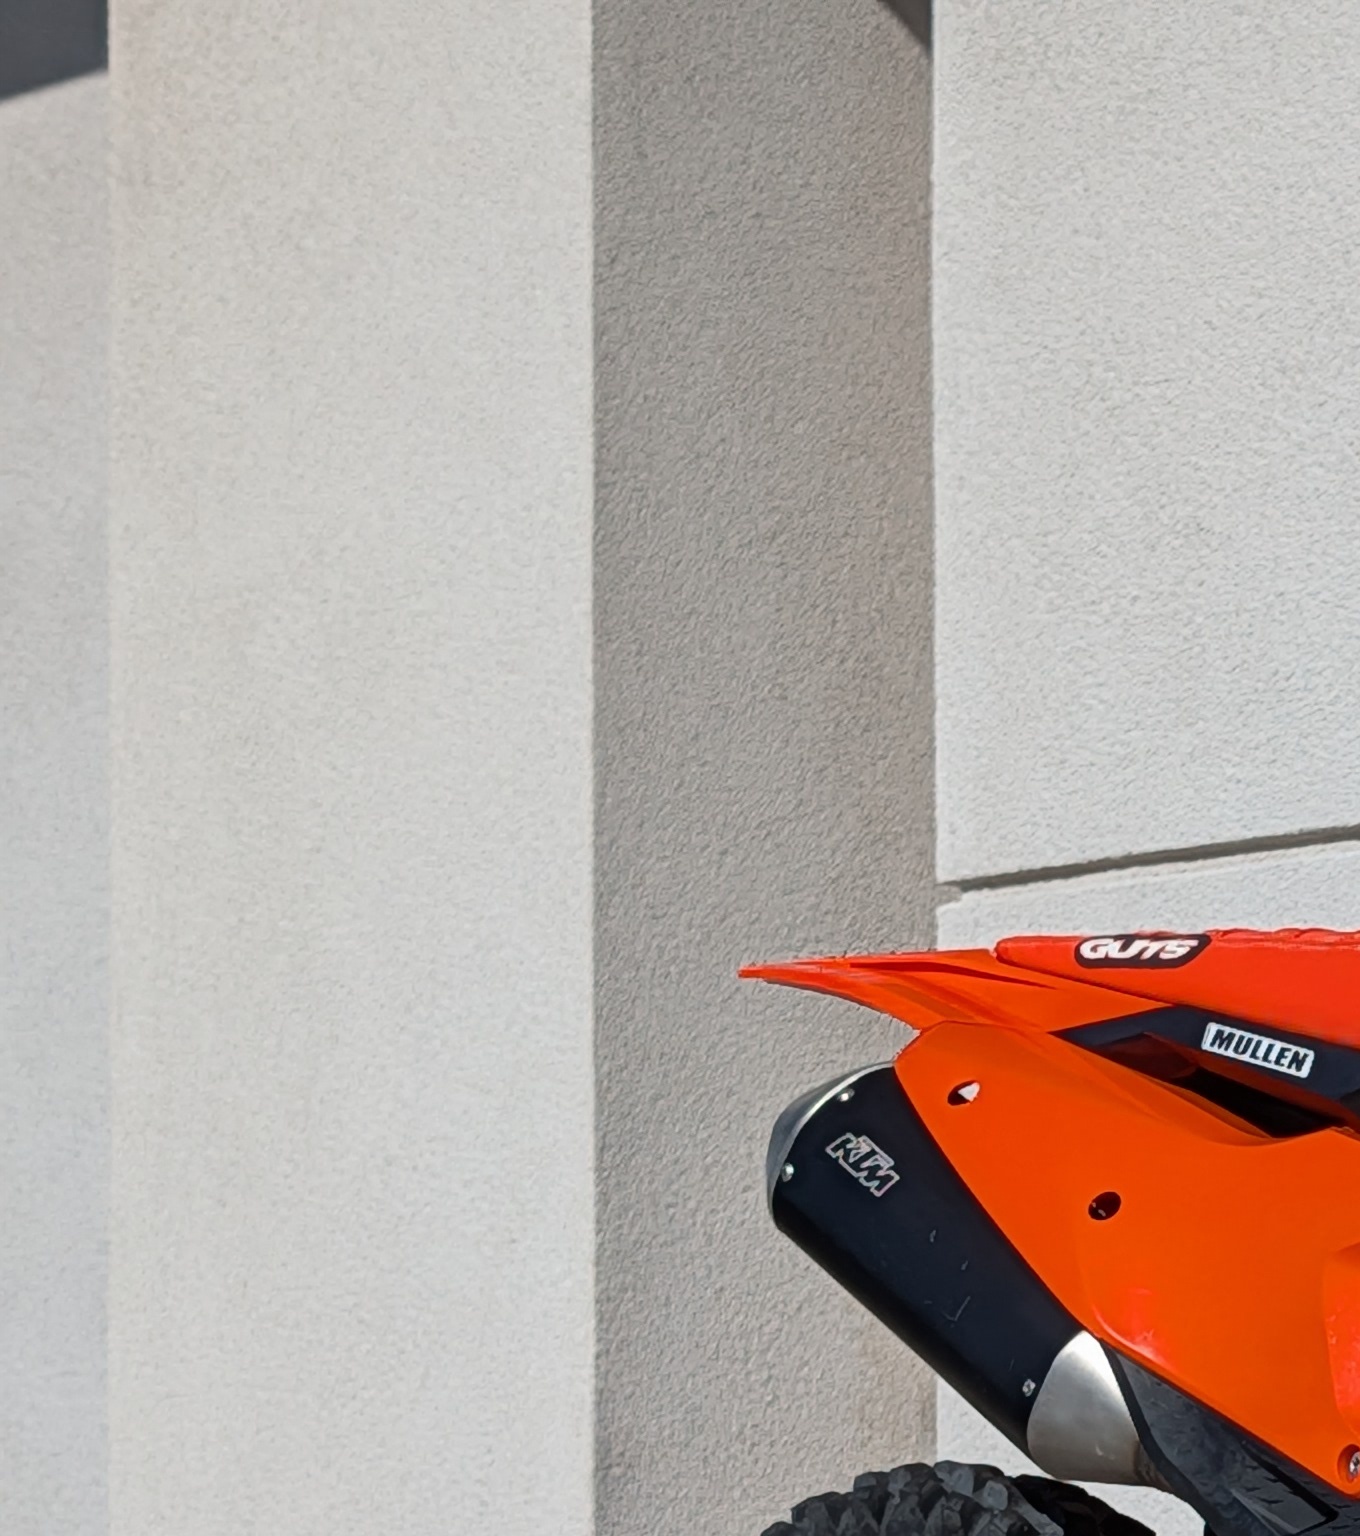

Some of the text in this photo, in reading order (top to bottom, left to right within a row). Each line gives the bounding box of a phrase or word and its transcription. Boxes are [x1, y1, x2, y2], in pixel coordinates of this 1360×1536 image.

[1079, 937, 1200, 961] GUTS
[1209, 1027, 1309, 1073] MULLEN
[825, 1131, 901, 1198] KTM
